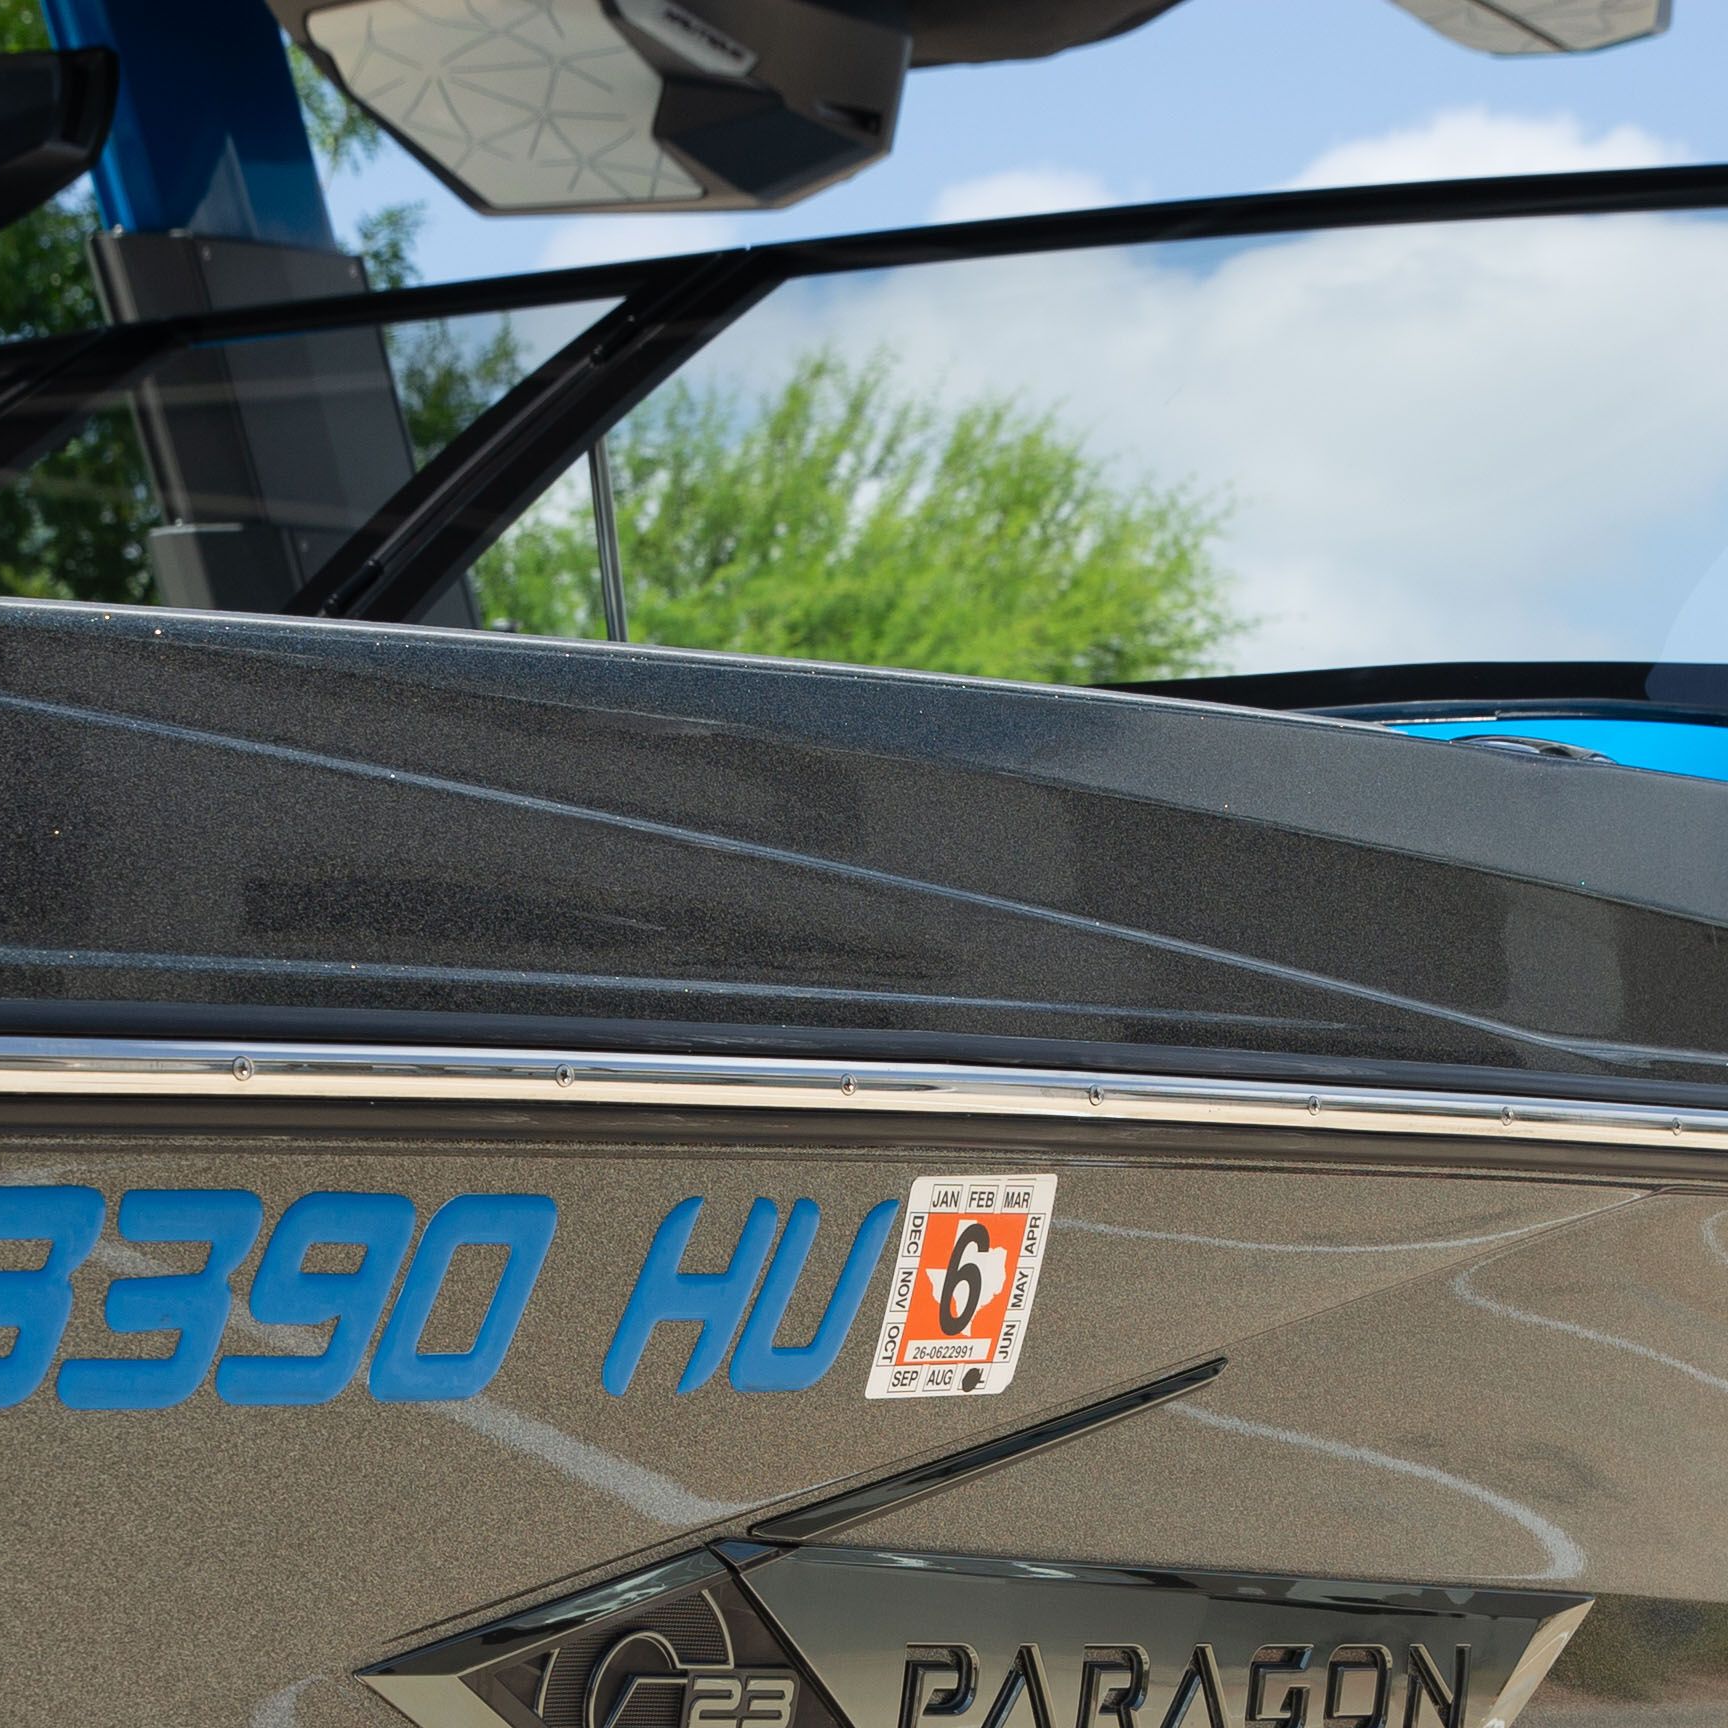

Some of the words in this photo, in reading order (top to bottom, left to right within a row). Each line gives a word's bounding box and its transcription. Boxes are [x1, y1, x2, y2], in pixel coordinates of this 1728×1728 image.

[932, 1190, 960, 1209] JAN
[968, 1190, 995, 1209] FEB
[1003, 1190, 1031, 1209] MAR
[906, 1214, 925, 1255] DEC
[1024, 1215, 1042, 1255] APR
[601, 1195, 900, 1396] HU
[895, 1270, 914, 1309] NOV
[939, 1223, 990, 1336] 6
[1011, 1270, 1030, 1309] MAY
[882, 1324, 901, 1364] OCT
[912, 1345, 974, 1360] 26-0622991
[998, 1323, 1017, 1360] JUN
[891, 1369, 919, 1388] SEP
[926, 1368, 954, 1387] AUG
